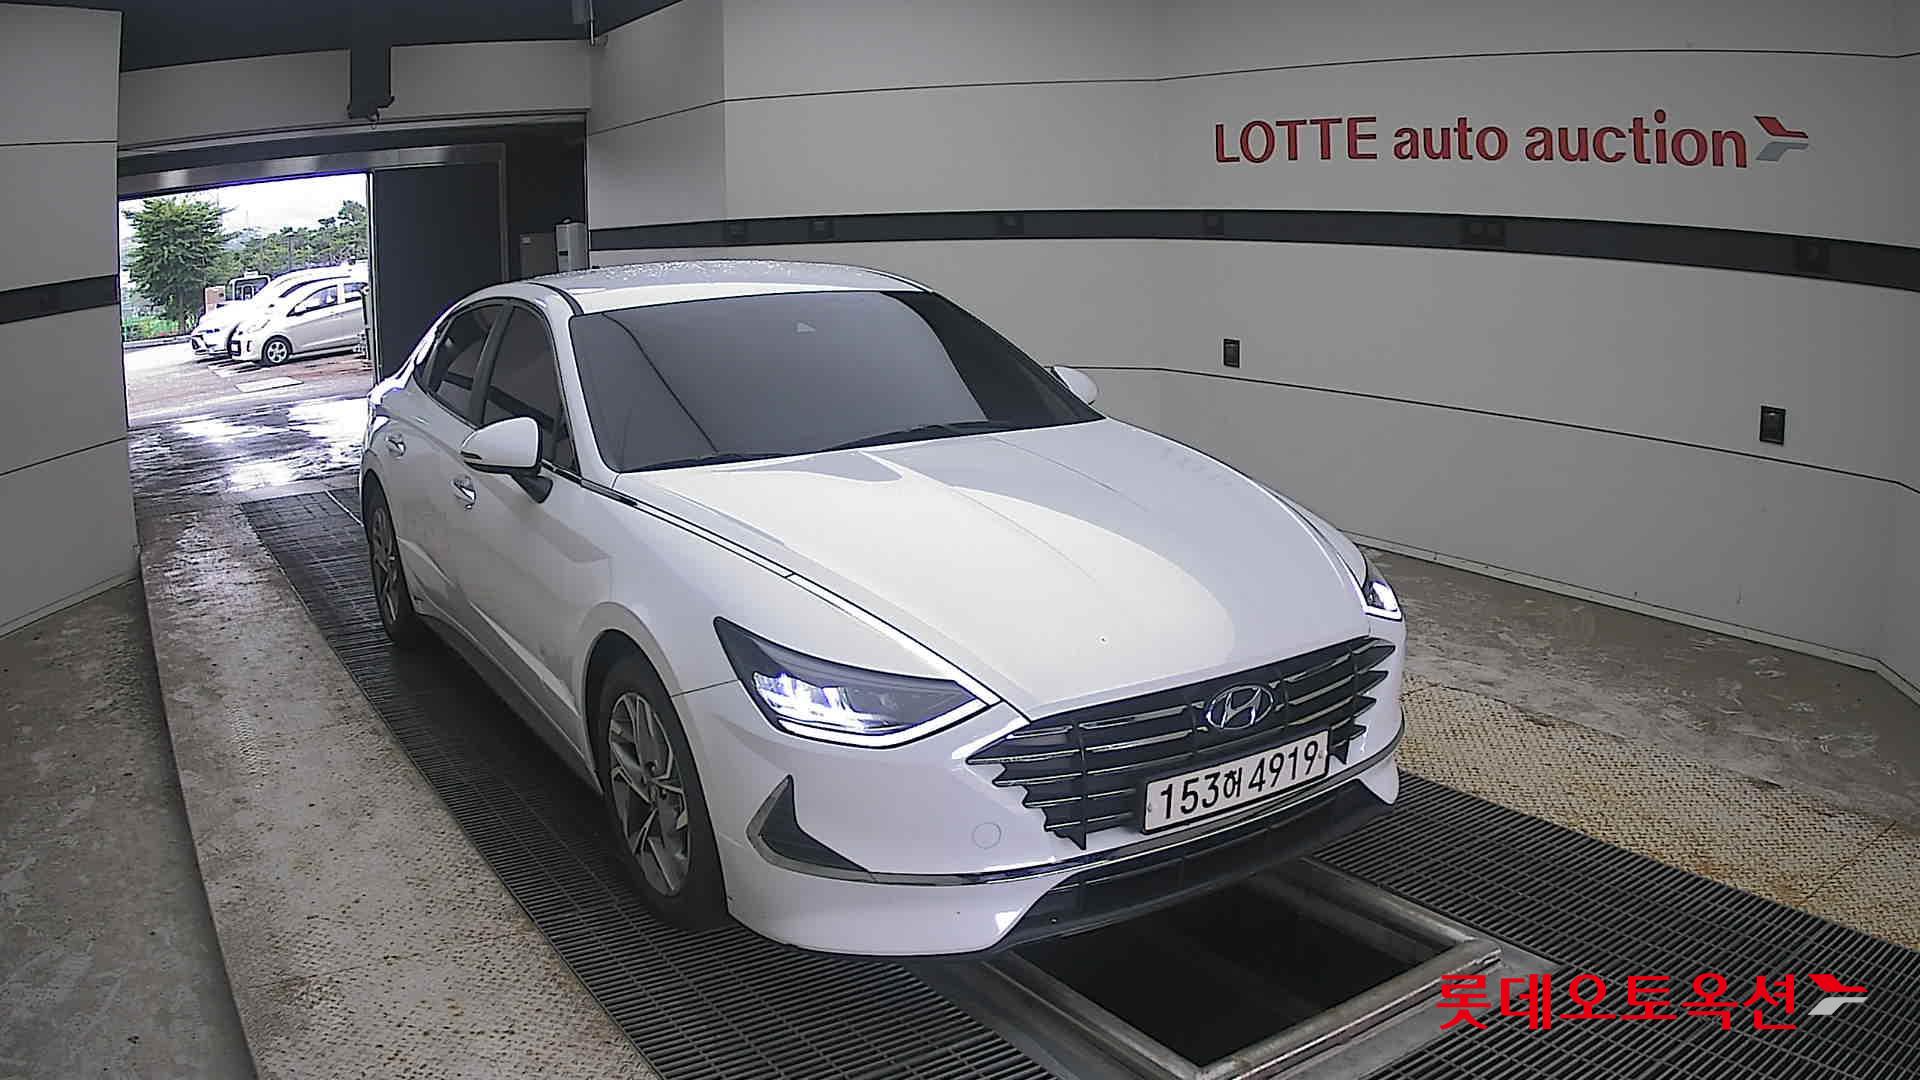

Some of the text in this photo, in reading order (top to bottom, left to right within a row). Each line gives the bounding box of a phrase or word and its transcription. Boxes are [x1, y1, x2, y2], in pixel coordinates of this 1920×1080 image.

[1215, 110, 1748, 168] LOTTE auto auction
